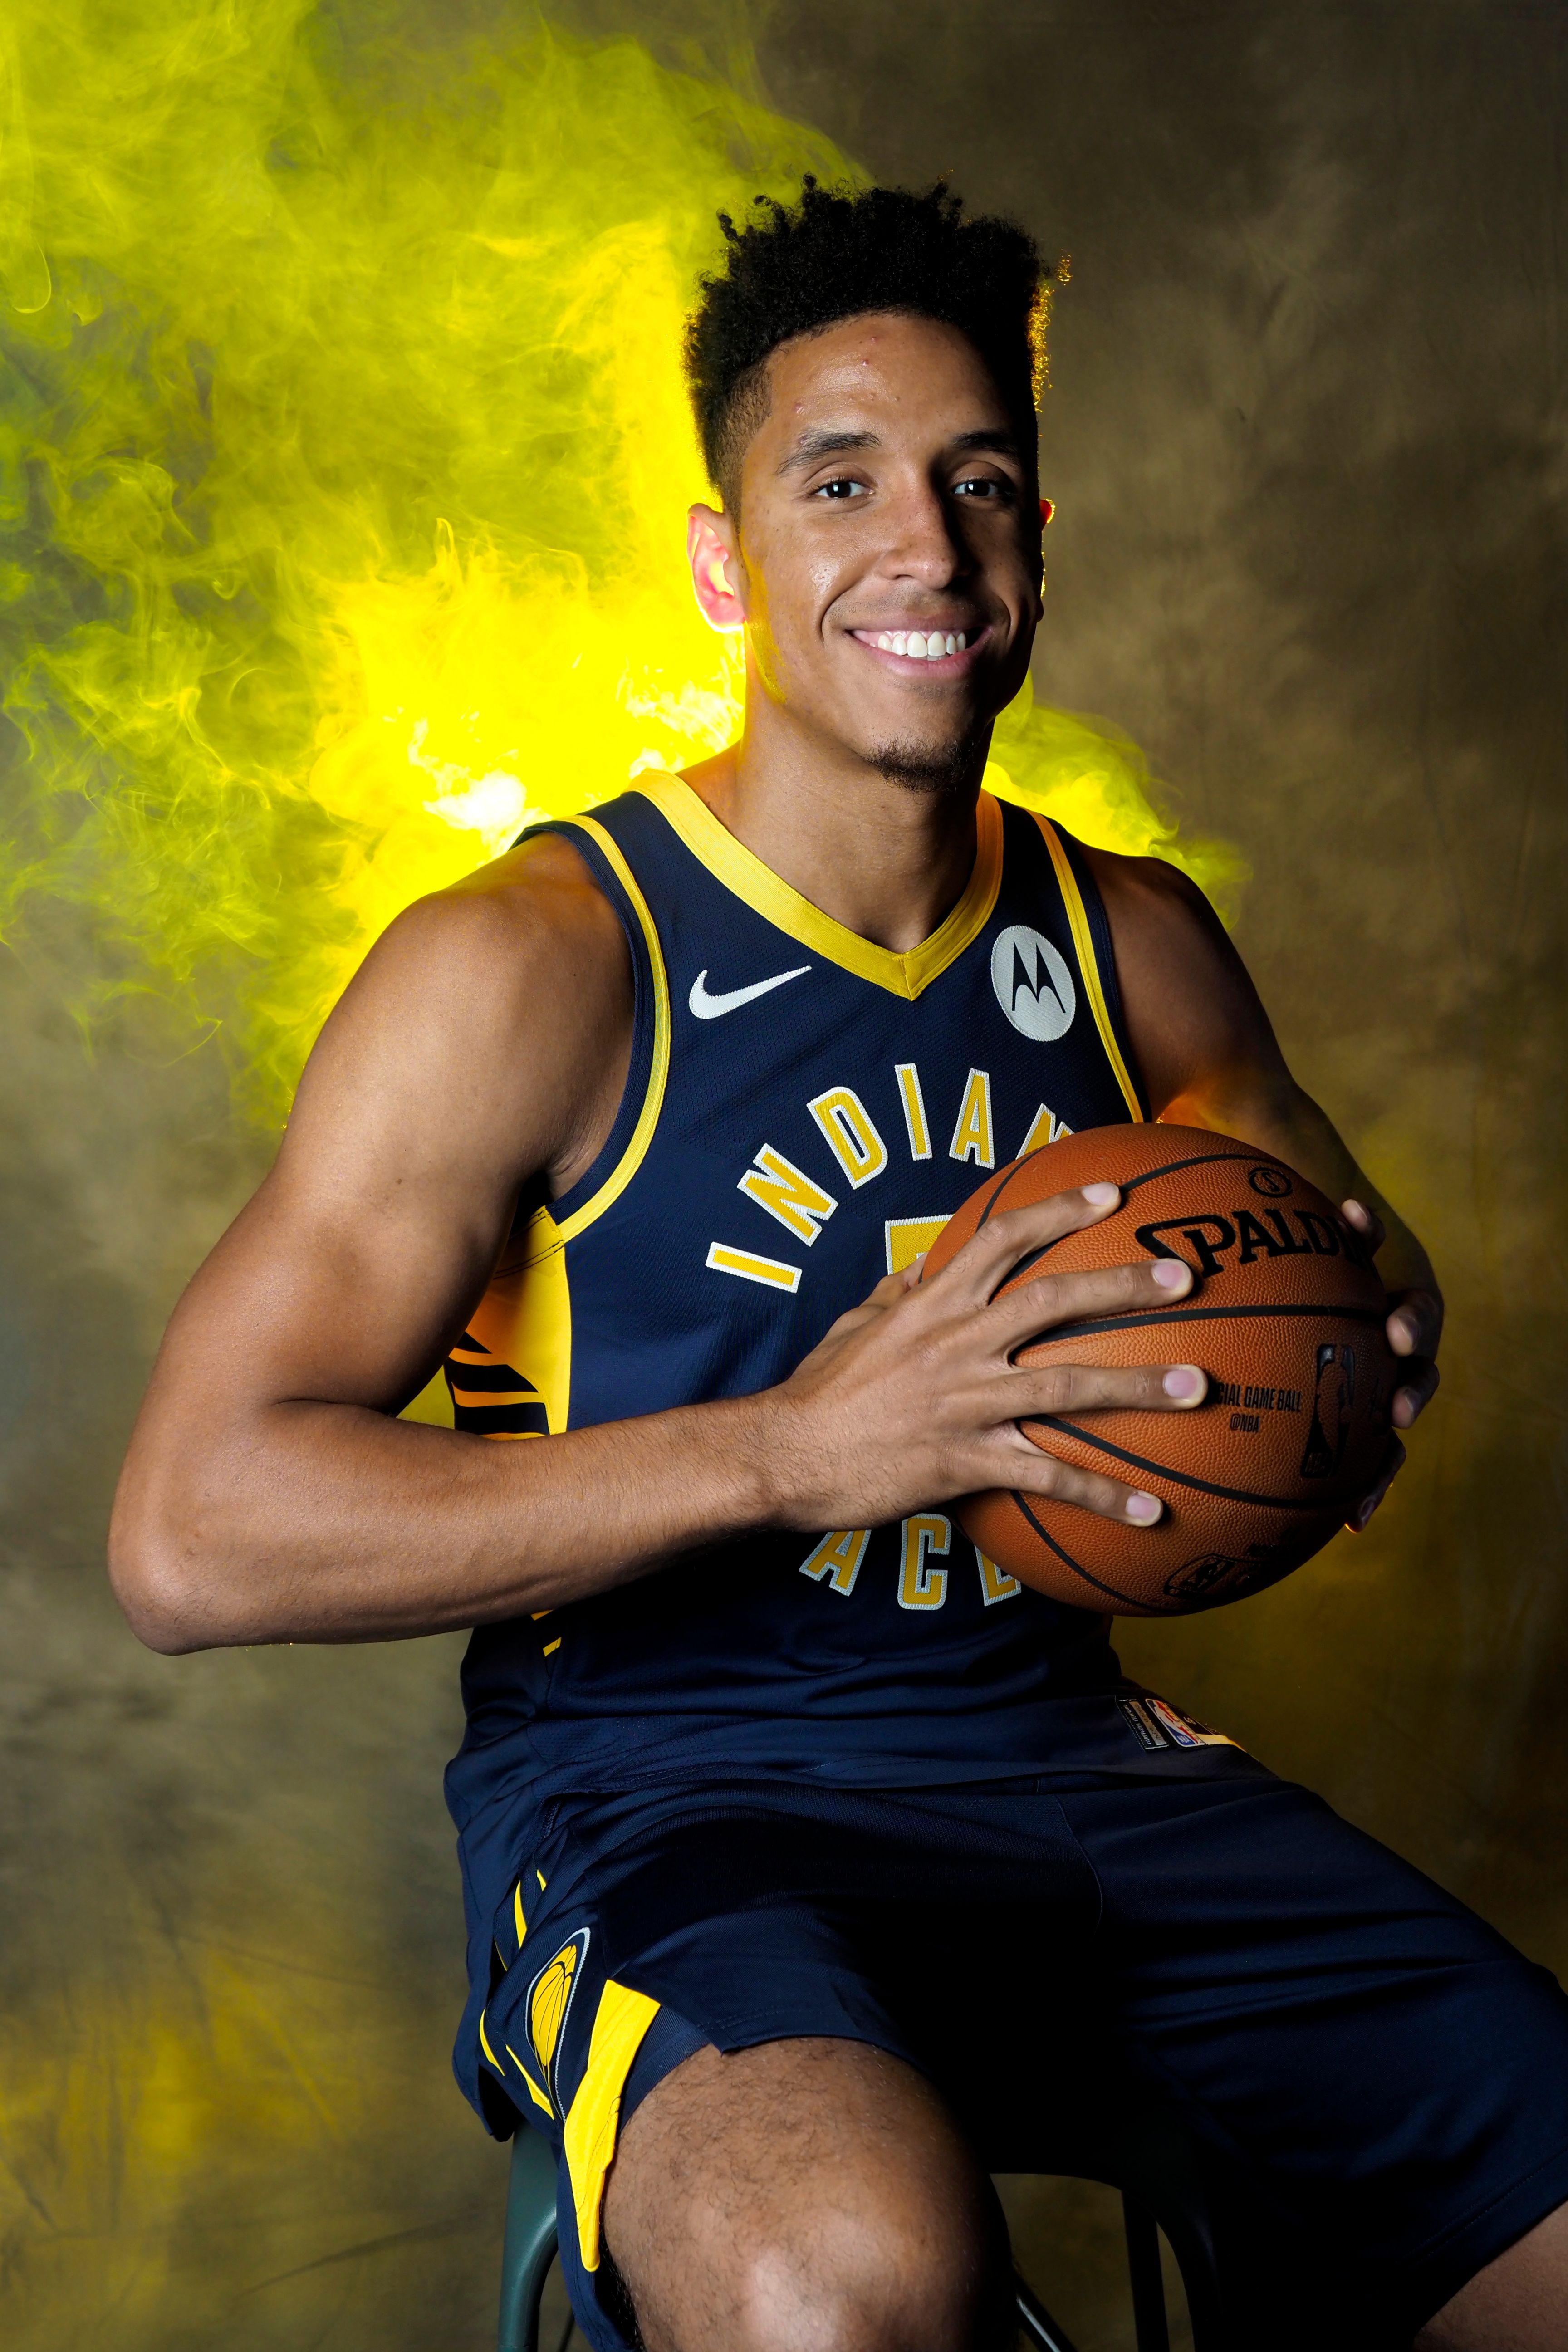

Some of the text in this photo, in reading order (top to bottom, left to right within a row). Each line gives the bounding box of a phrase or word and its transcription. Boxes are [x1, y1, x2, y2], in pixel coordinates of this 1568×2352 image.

[1244, 1386, 1277, 1410] GAME
[1277, 1389, 1302, 1412] BALL
[1230, 1413, 1260, 1433] @NBA
